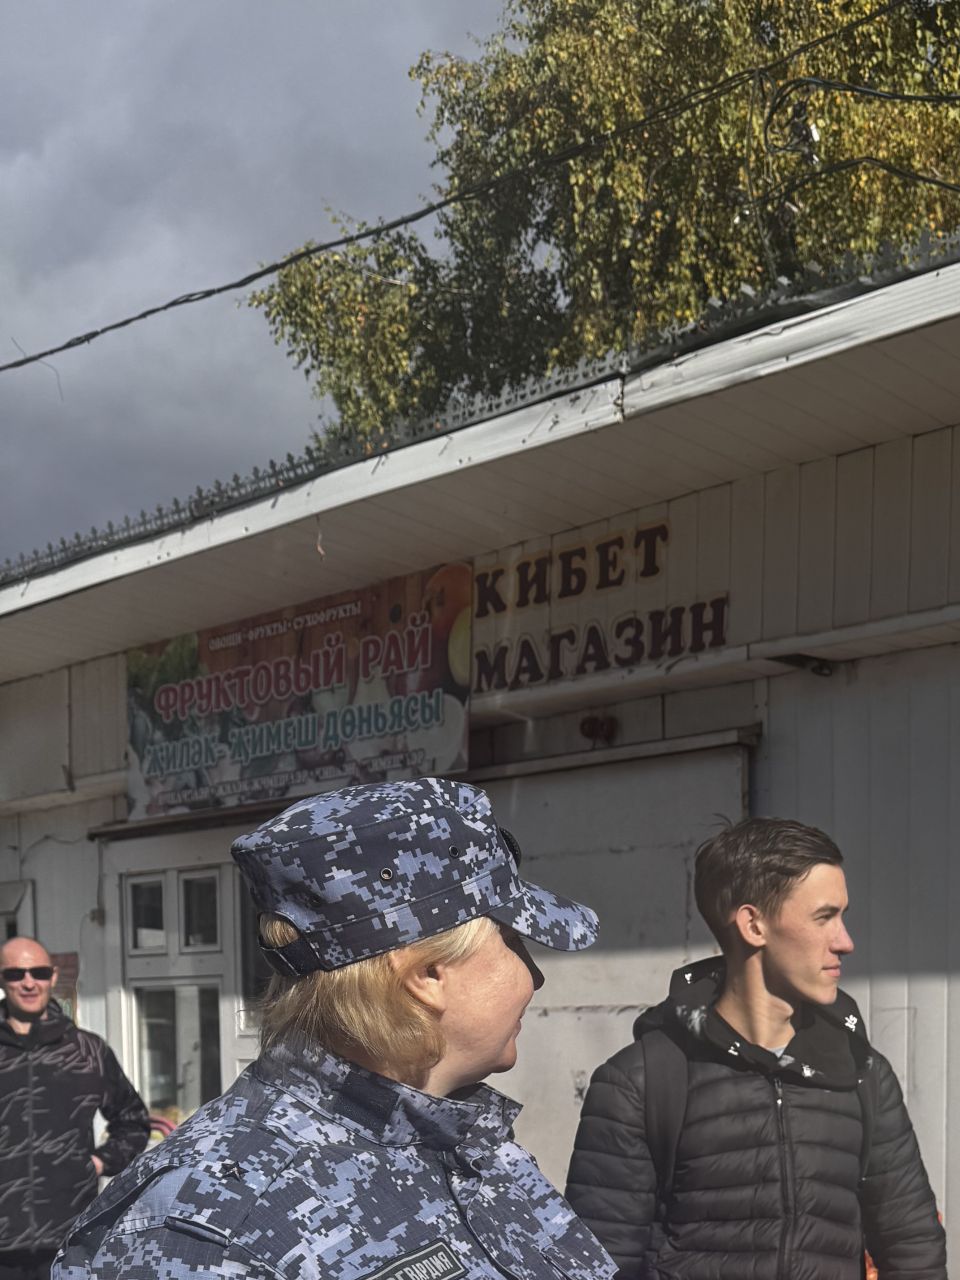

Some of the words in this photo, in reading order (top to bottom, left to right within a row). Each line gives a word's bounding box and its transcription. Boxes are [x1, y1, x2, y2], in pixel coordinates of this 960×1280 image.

[475, 524, 668, 618] КИБЕТ
[155, 632, 347, 724] ФРУКТОВЫЙ
[360, 610, 432, 682] РАЙ
[474, 594, 730, 693] МАГАЗИН
[322, 688, 445, 750] ДӨНЬЯСЫ
